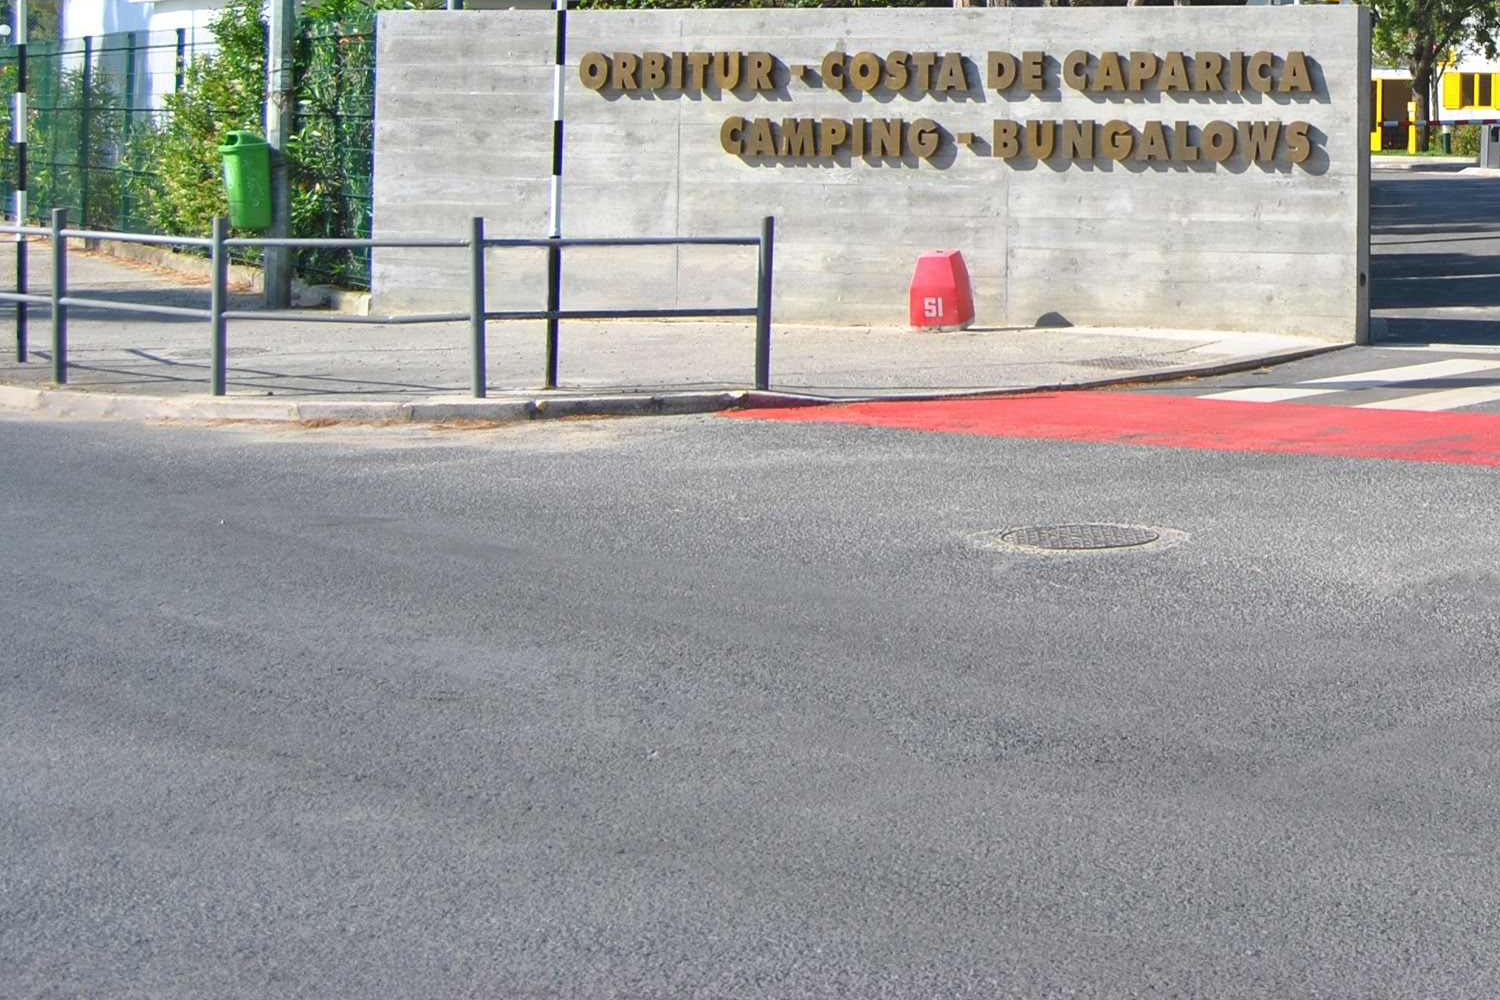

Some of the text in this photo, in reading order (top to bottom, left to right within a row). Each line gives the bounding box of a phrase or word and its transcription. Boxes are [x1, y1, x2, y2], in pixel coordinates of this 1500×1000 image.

[578, 50, 776, 91] ORBITUR
[821, 50, 971, 92] COSTA
[987, 51, 1046, 91] DE
[1062, 49, 1314, 92] CAPARICA
[719, 115, 940, 159] CAMPING
[992, 119, 1314, 163] BUNGALOWS
